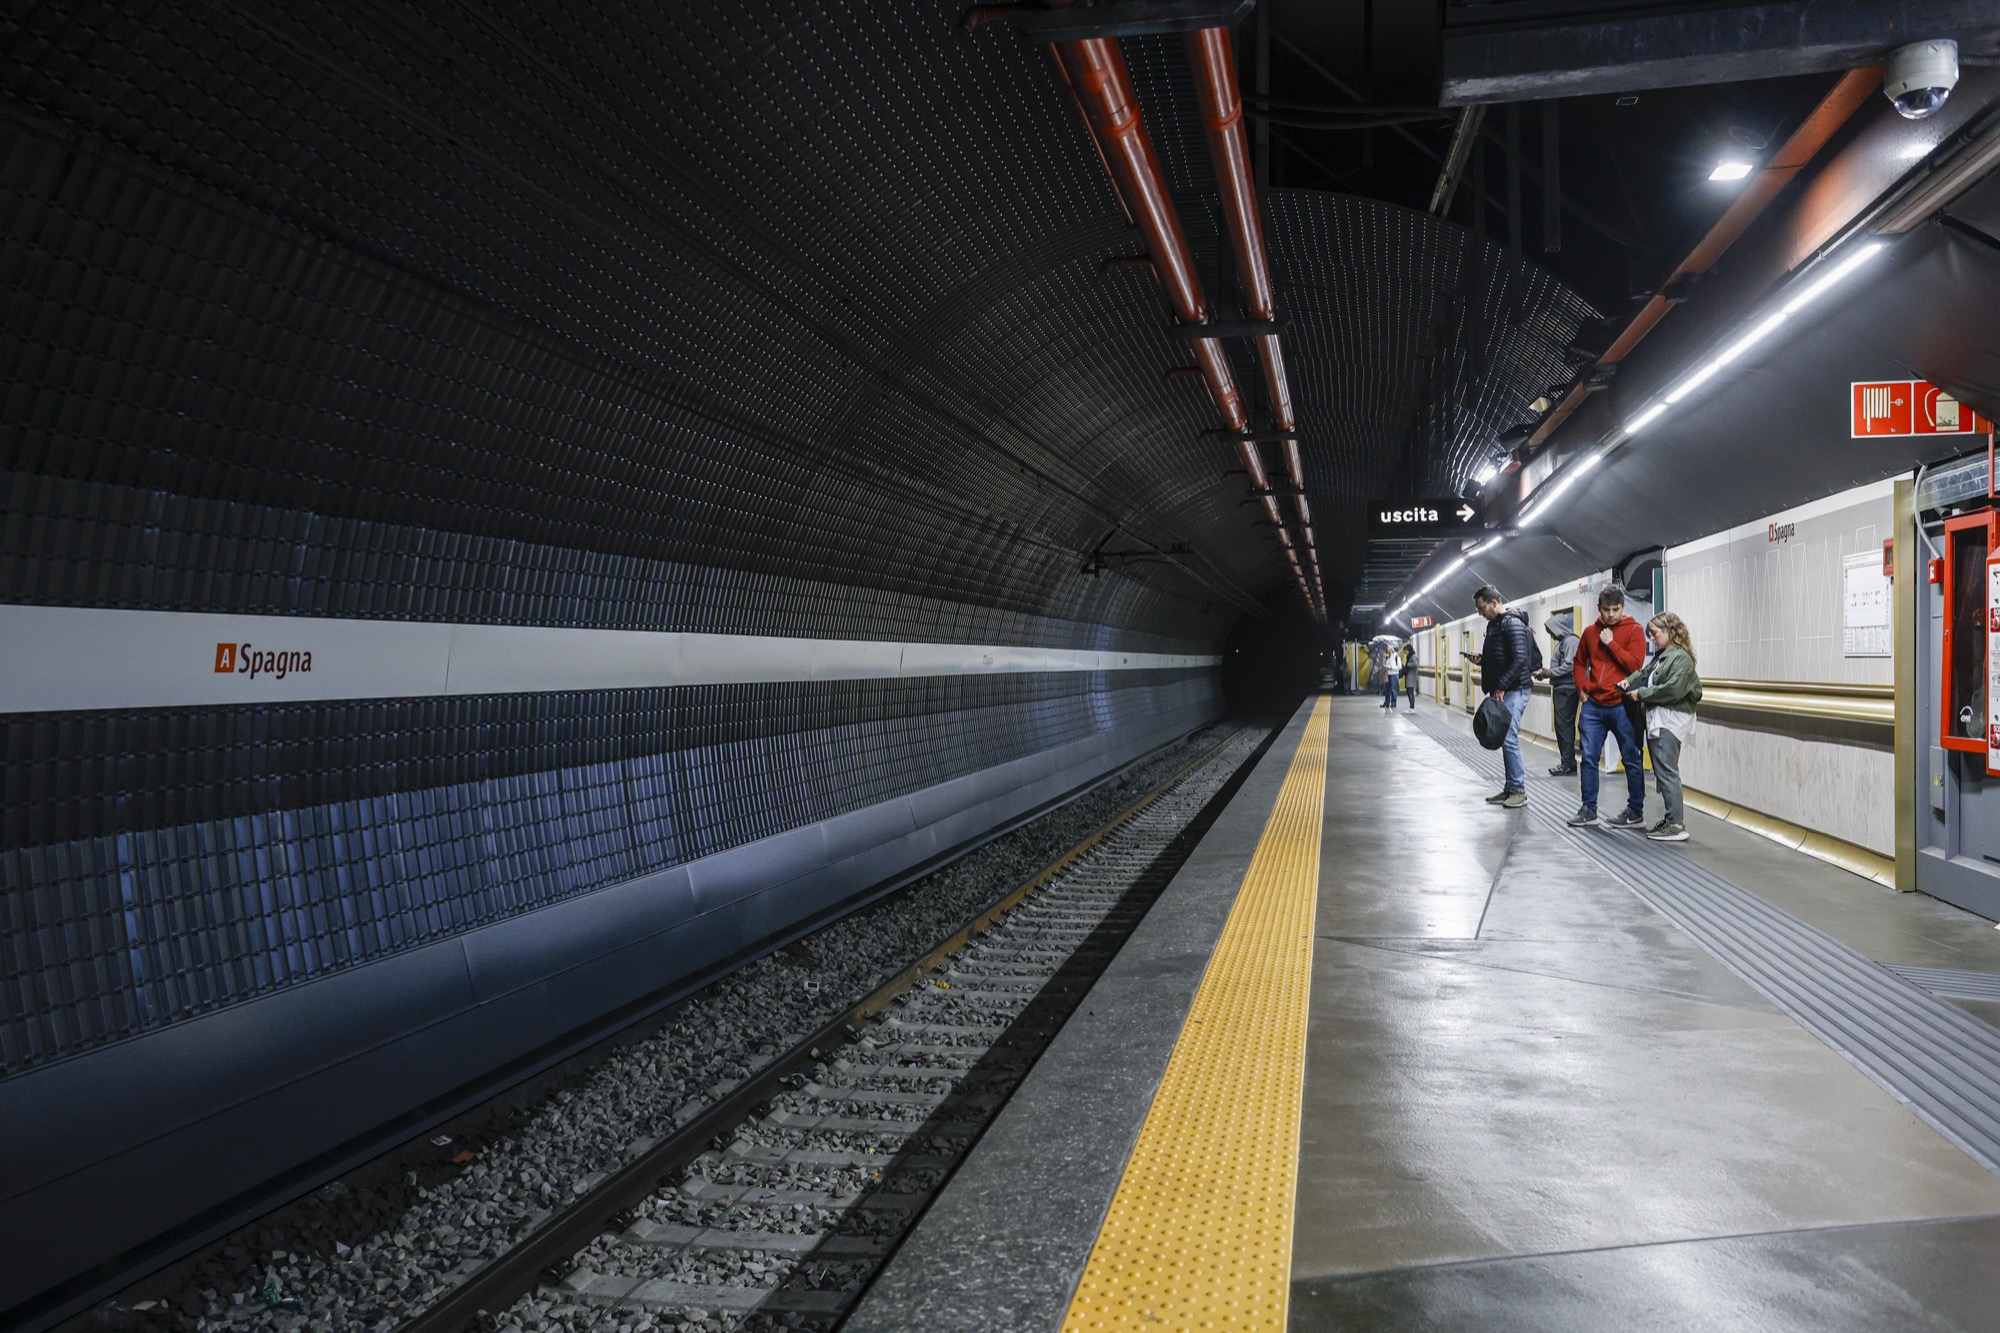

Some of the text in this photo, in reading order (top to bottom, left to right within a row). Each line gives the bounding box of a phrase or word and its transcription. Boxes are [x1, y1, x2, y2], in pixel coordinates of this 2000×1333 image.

[1380, 507, 1439, 523] uscita
[1774, 522, 1795, 544] Spagna
[238, 643, 312, 680] Spagna
